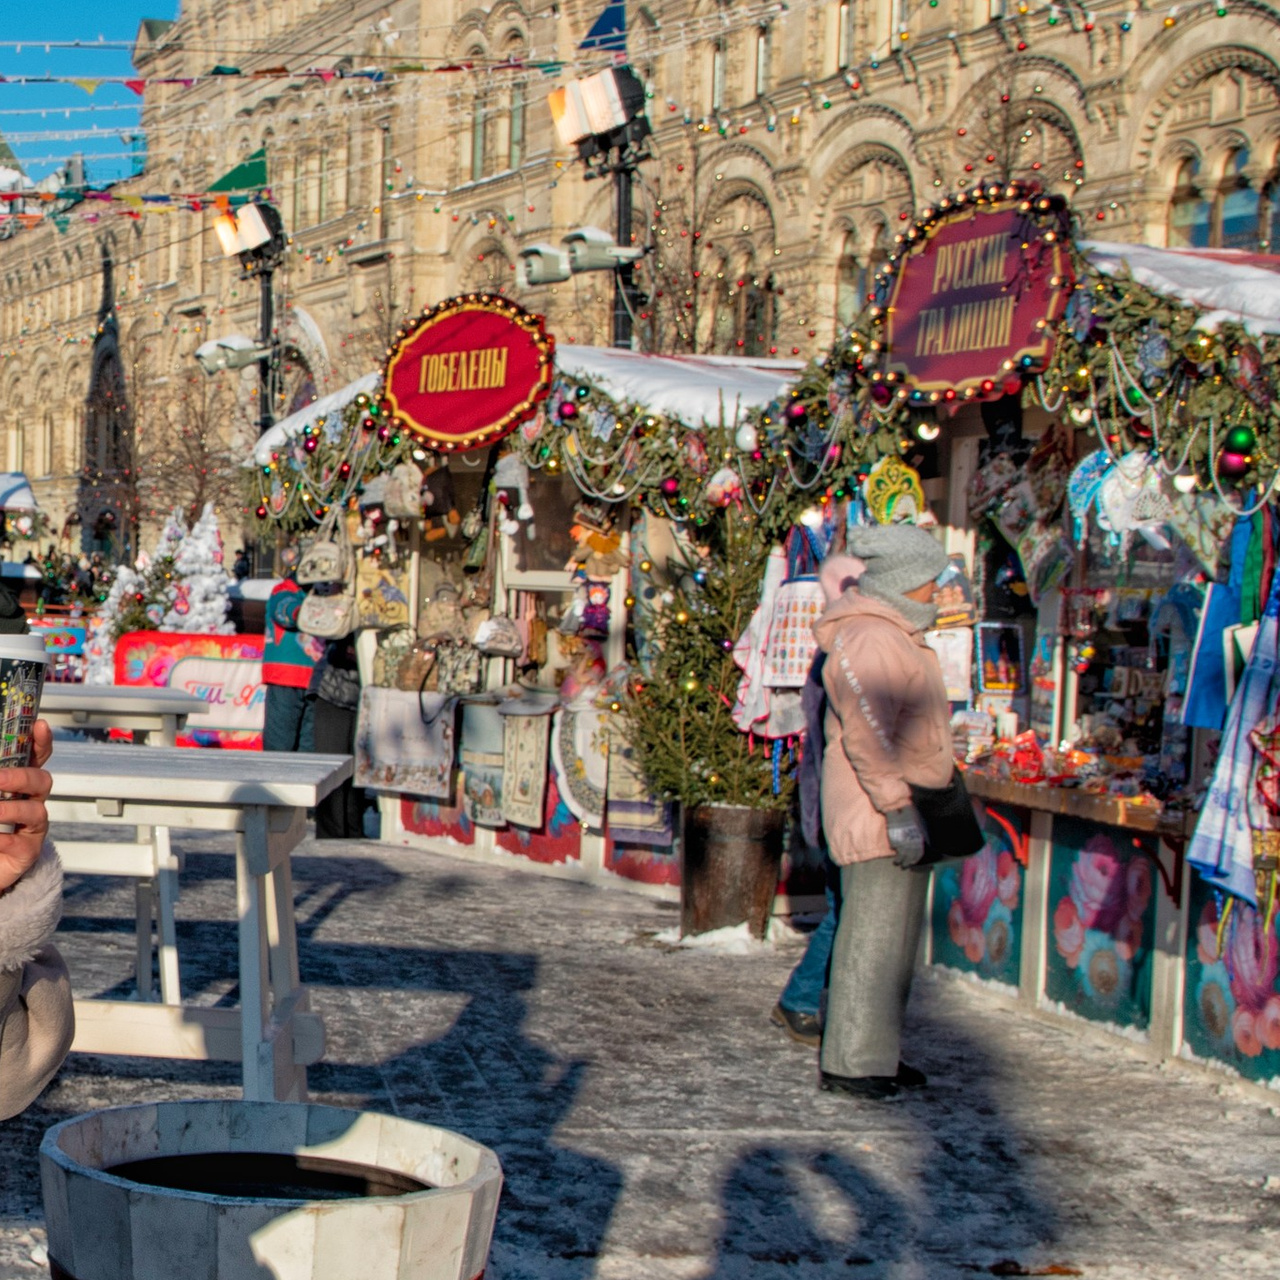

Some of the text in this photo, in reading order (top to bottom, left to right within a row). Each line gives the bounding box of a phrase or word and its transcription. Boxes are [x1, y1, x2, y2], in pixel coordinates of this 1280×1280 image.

[931, 232, 1011, 295] РУССКИЕ
[915, 295, 1016, 357] ТРАДИЦИИ
[418, 346, 509, 394] ГОБЕЛЕНЫ
